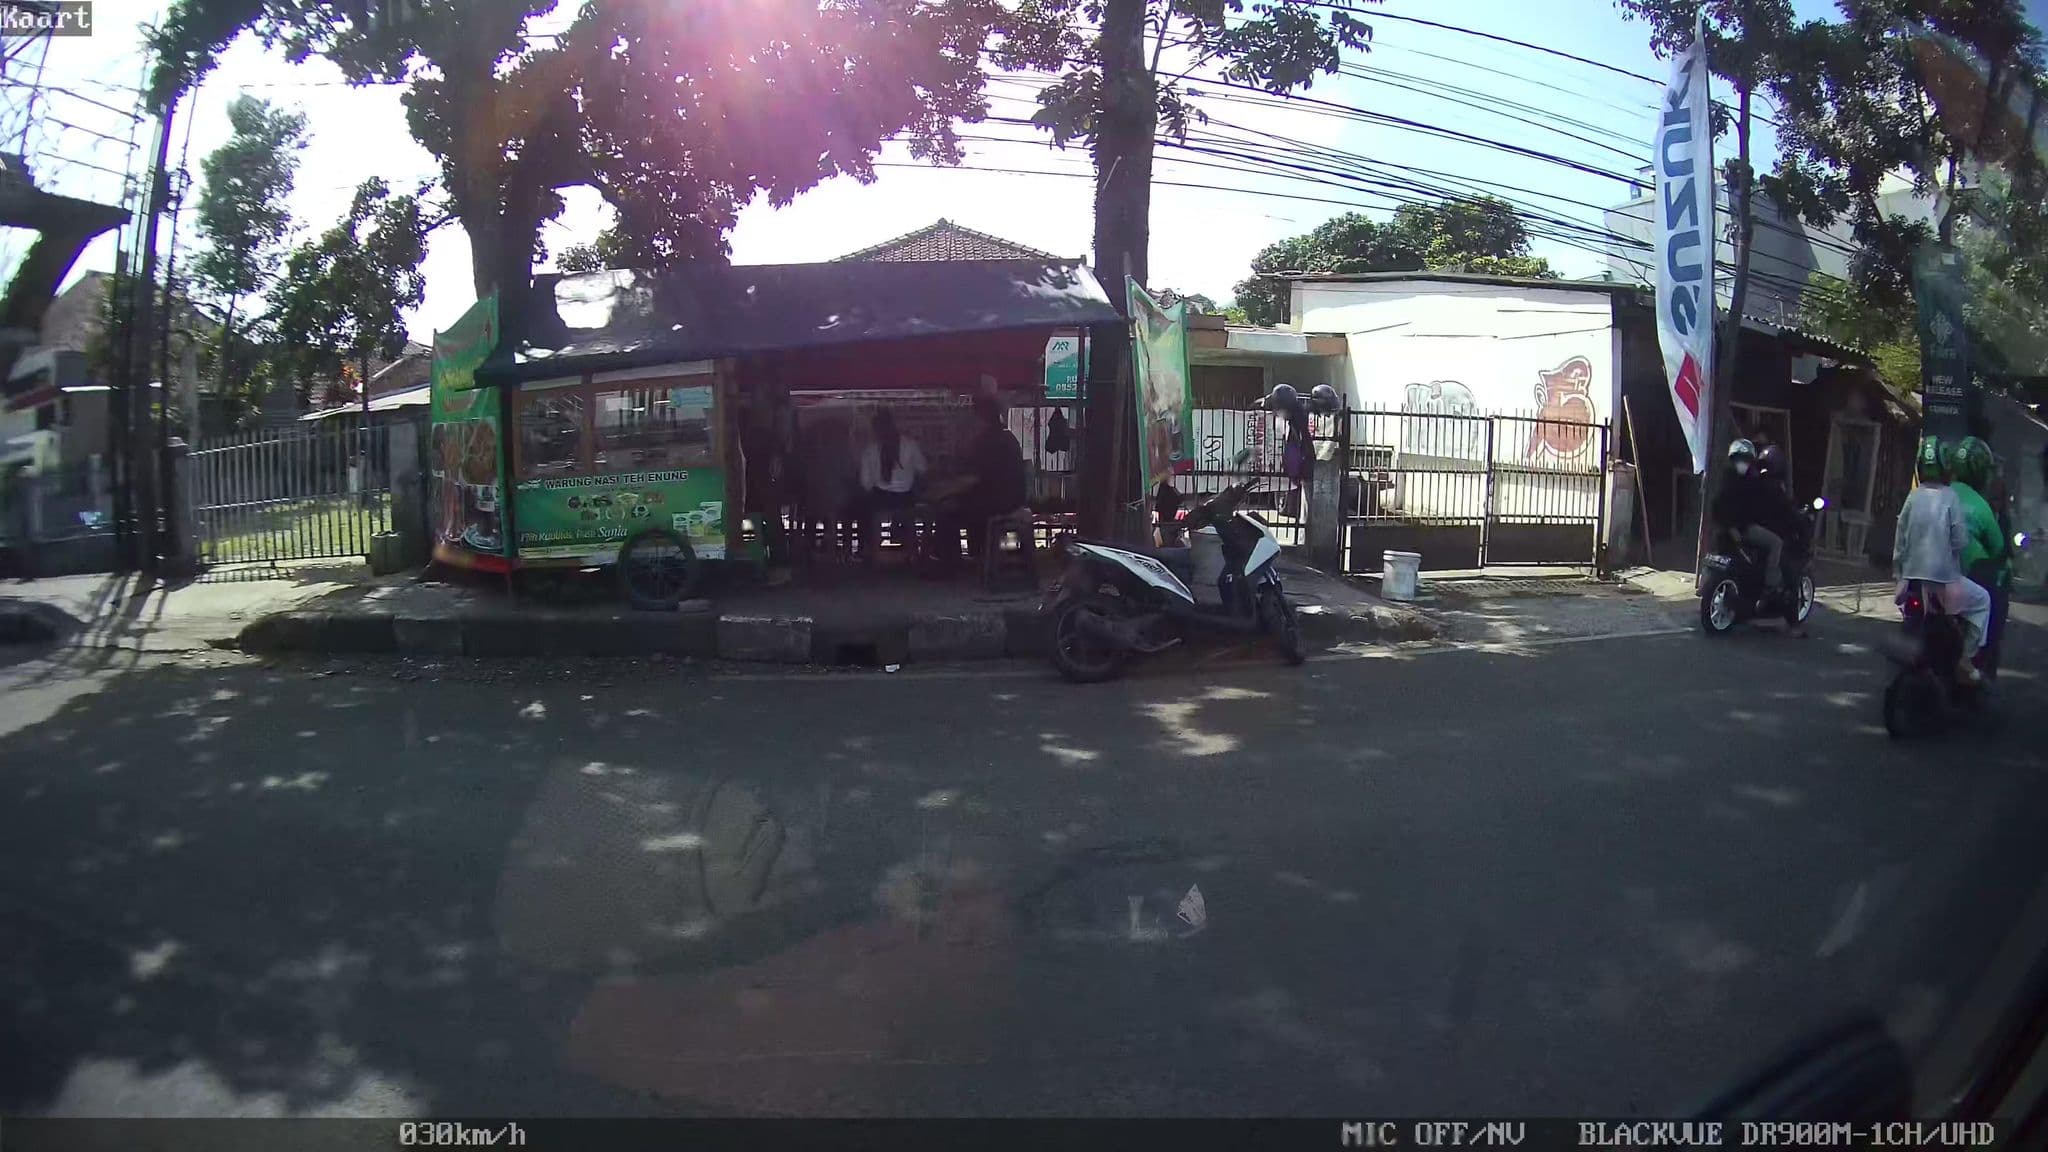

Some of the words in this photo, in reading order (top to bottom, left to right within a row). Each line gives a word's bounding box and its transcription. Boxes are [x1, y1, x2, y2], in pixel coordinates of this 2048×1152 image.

[545, 476, 592, 490] WARUNG
[594, 474, 620, 487] NASI
[623, 472, 645, 485] TEH
[647, 470, 688, 483] ENUNG
[599, 525, 628, 538] Sania
